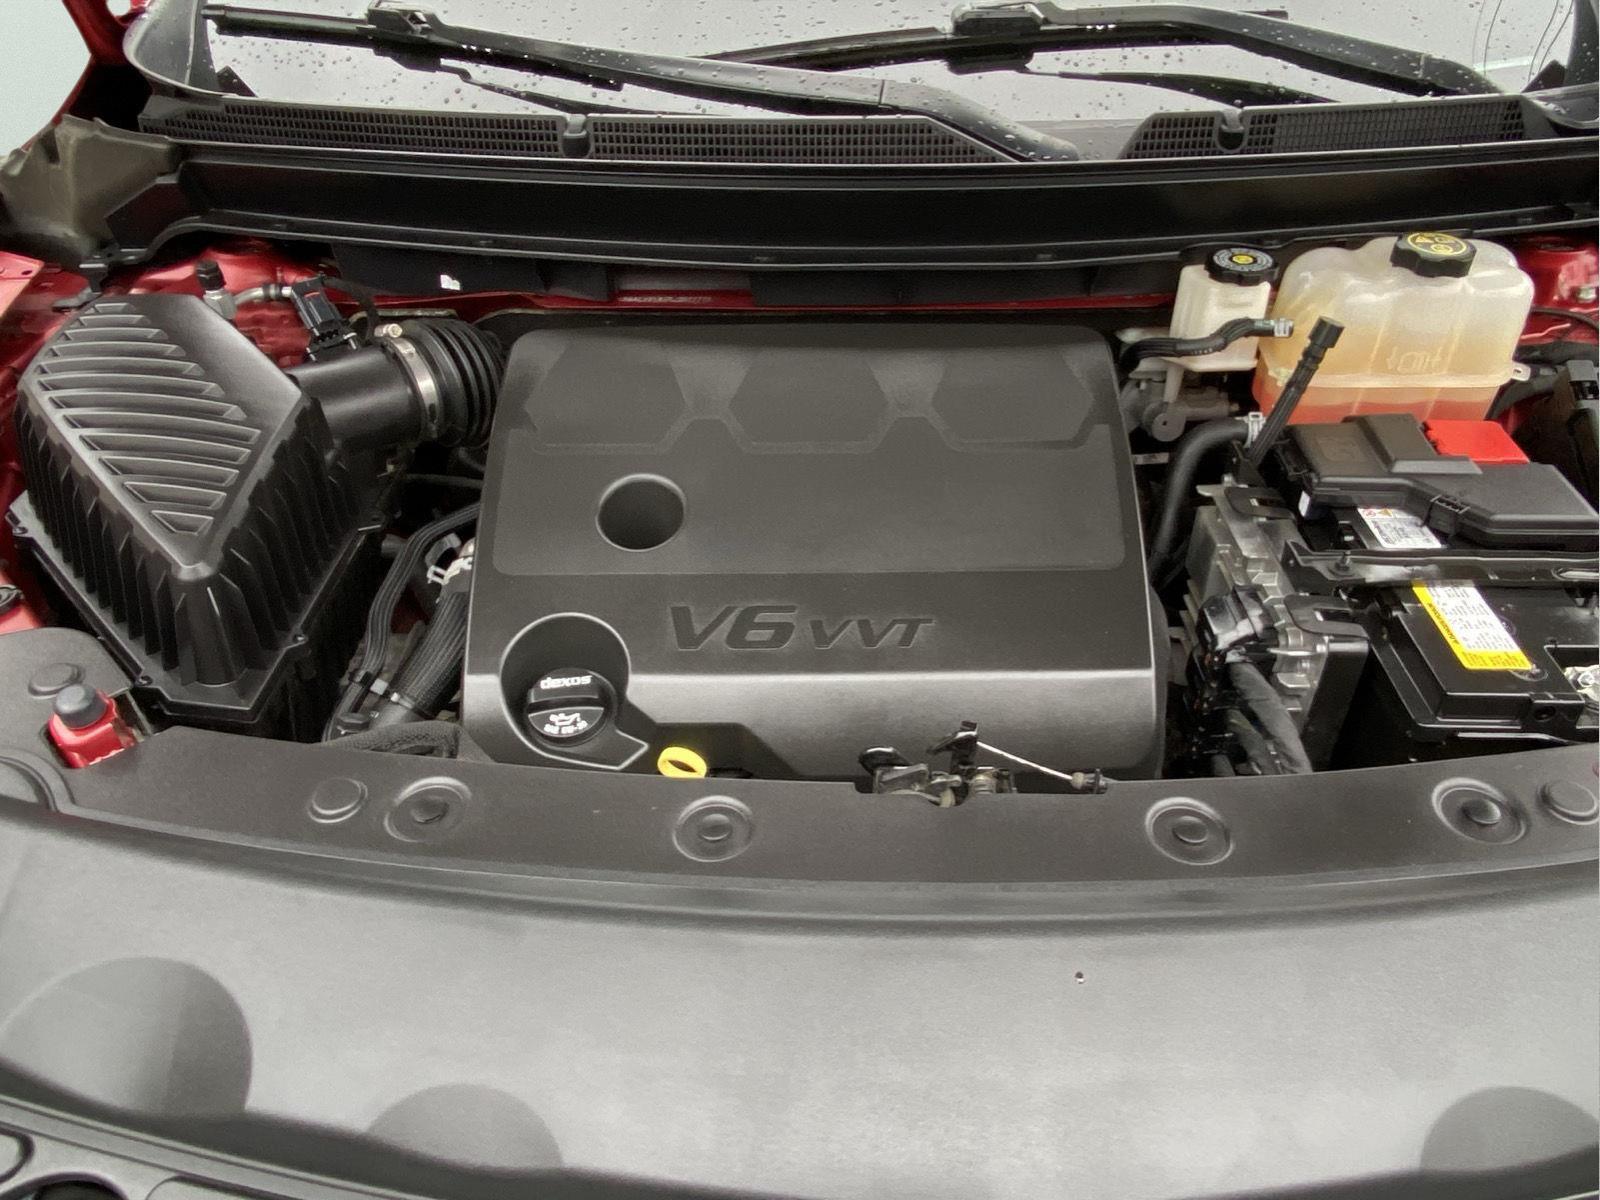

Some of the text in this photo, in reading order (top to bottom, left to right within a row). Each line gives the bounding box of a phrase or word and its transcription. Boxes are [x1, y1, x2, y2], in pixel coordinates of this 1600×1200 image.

[670, 604, 936, 651] V6 VVT
[539, 674, 593, 690] dexos
